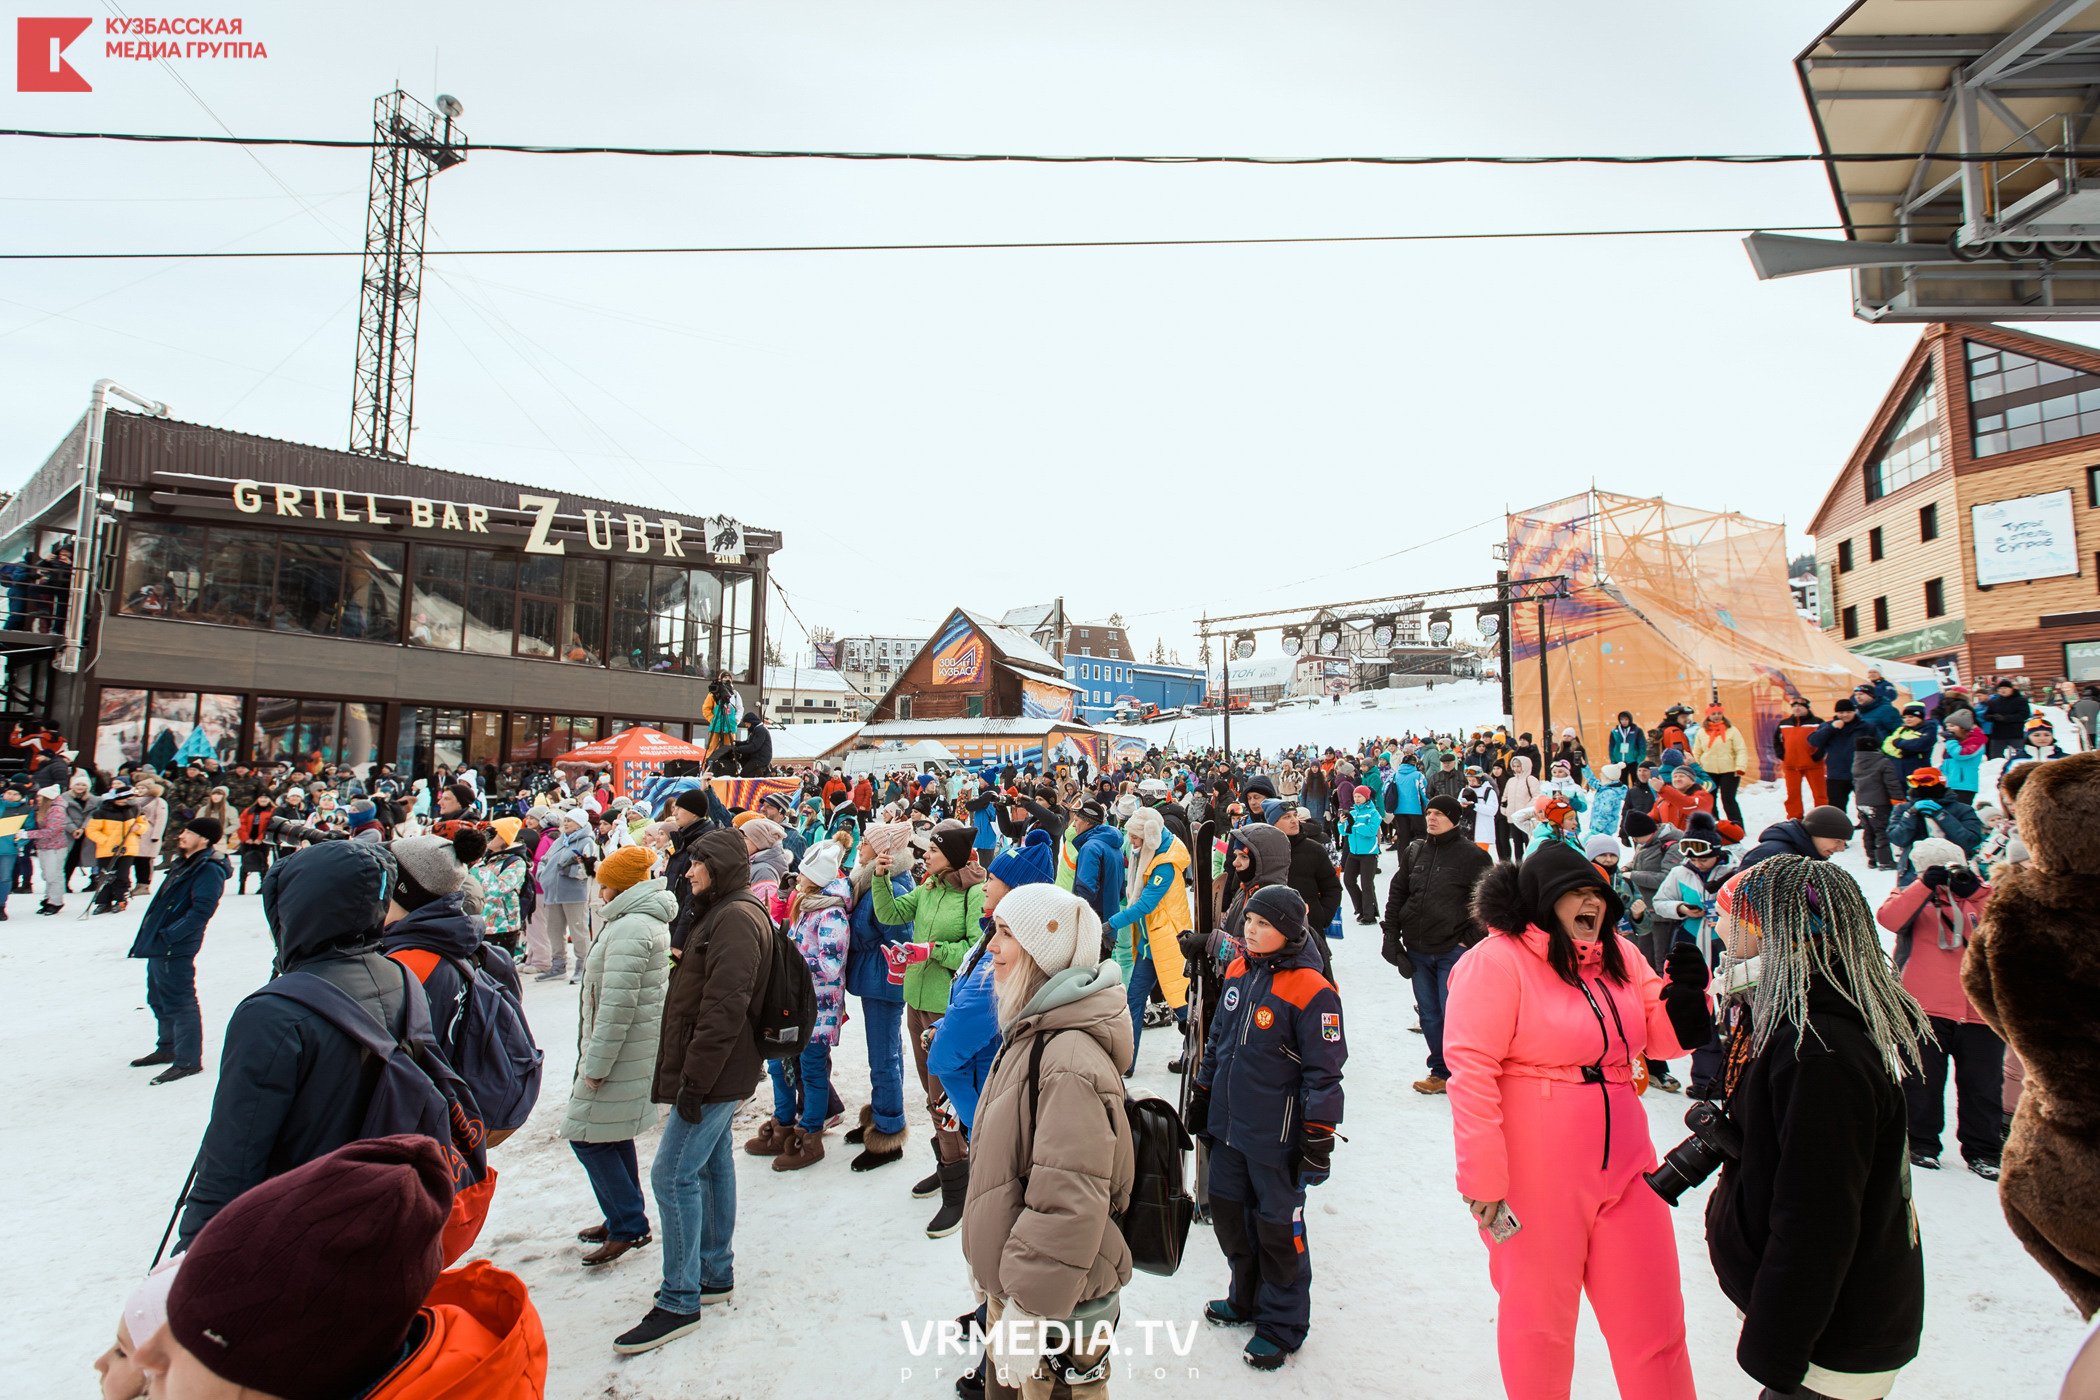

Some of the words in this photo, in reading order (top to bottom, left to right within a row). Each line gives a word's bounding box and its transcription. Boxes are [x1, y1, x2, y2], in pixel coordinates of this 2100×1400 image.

[233, 482, 391, 525] GRILL
[411, 499, 489, 534] BAR
[1995, 538, 2054, 553] Сугроб
[714, 554, 742, 564] ZUBR
[939, 657, 956, 667] 300
[938, 666, 978, 677] КУЗБАСС
